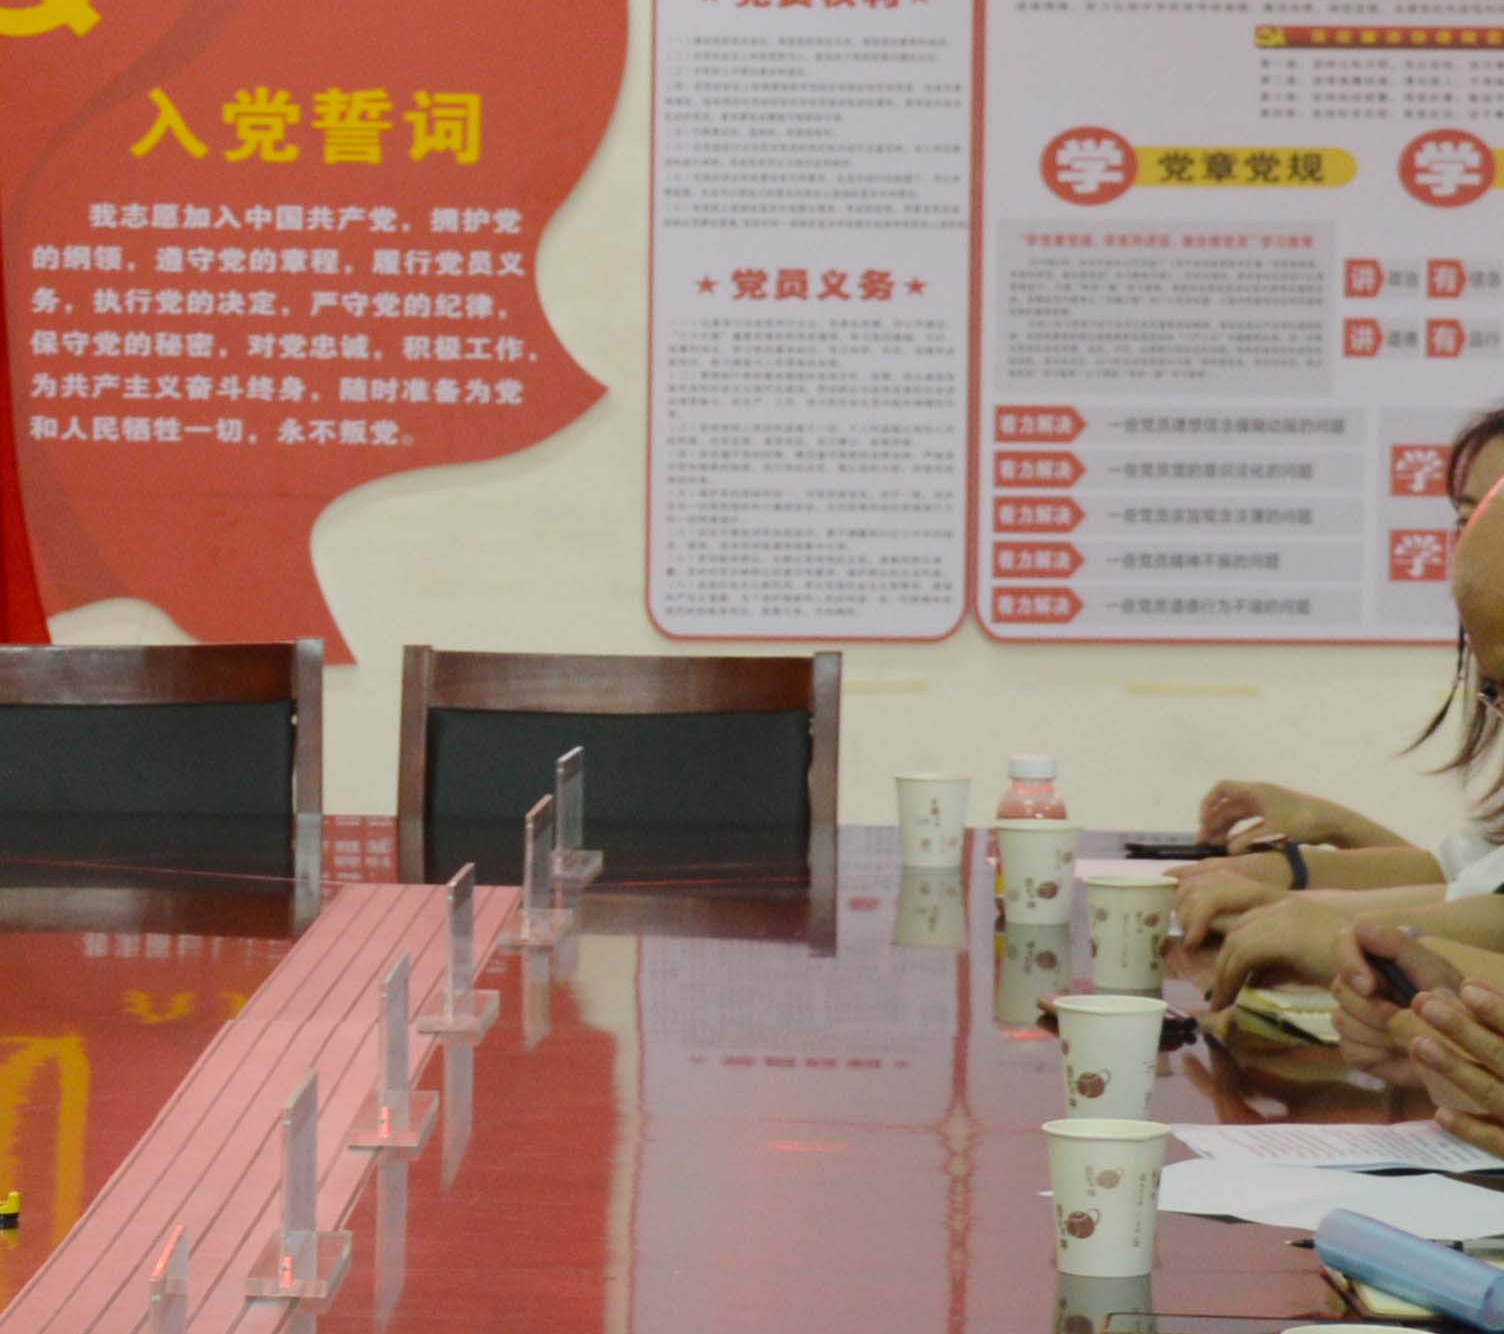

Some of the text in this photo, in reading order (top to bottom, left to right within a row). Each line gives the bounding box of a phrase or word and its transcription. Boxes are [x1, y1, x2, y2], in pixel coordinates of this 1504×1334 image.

[129, 86, 483, 166] 入党誓词
[1158, 152, 1326, 183] 党章党规
[730, 269, 896, 302] 党员义务
